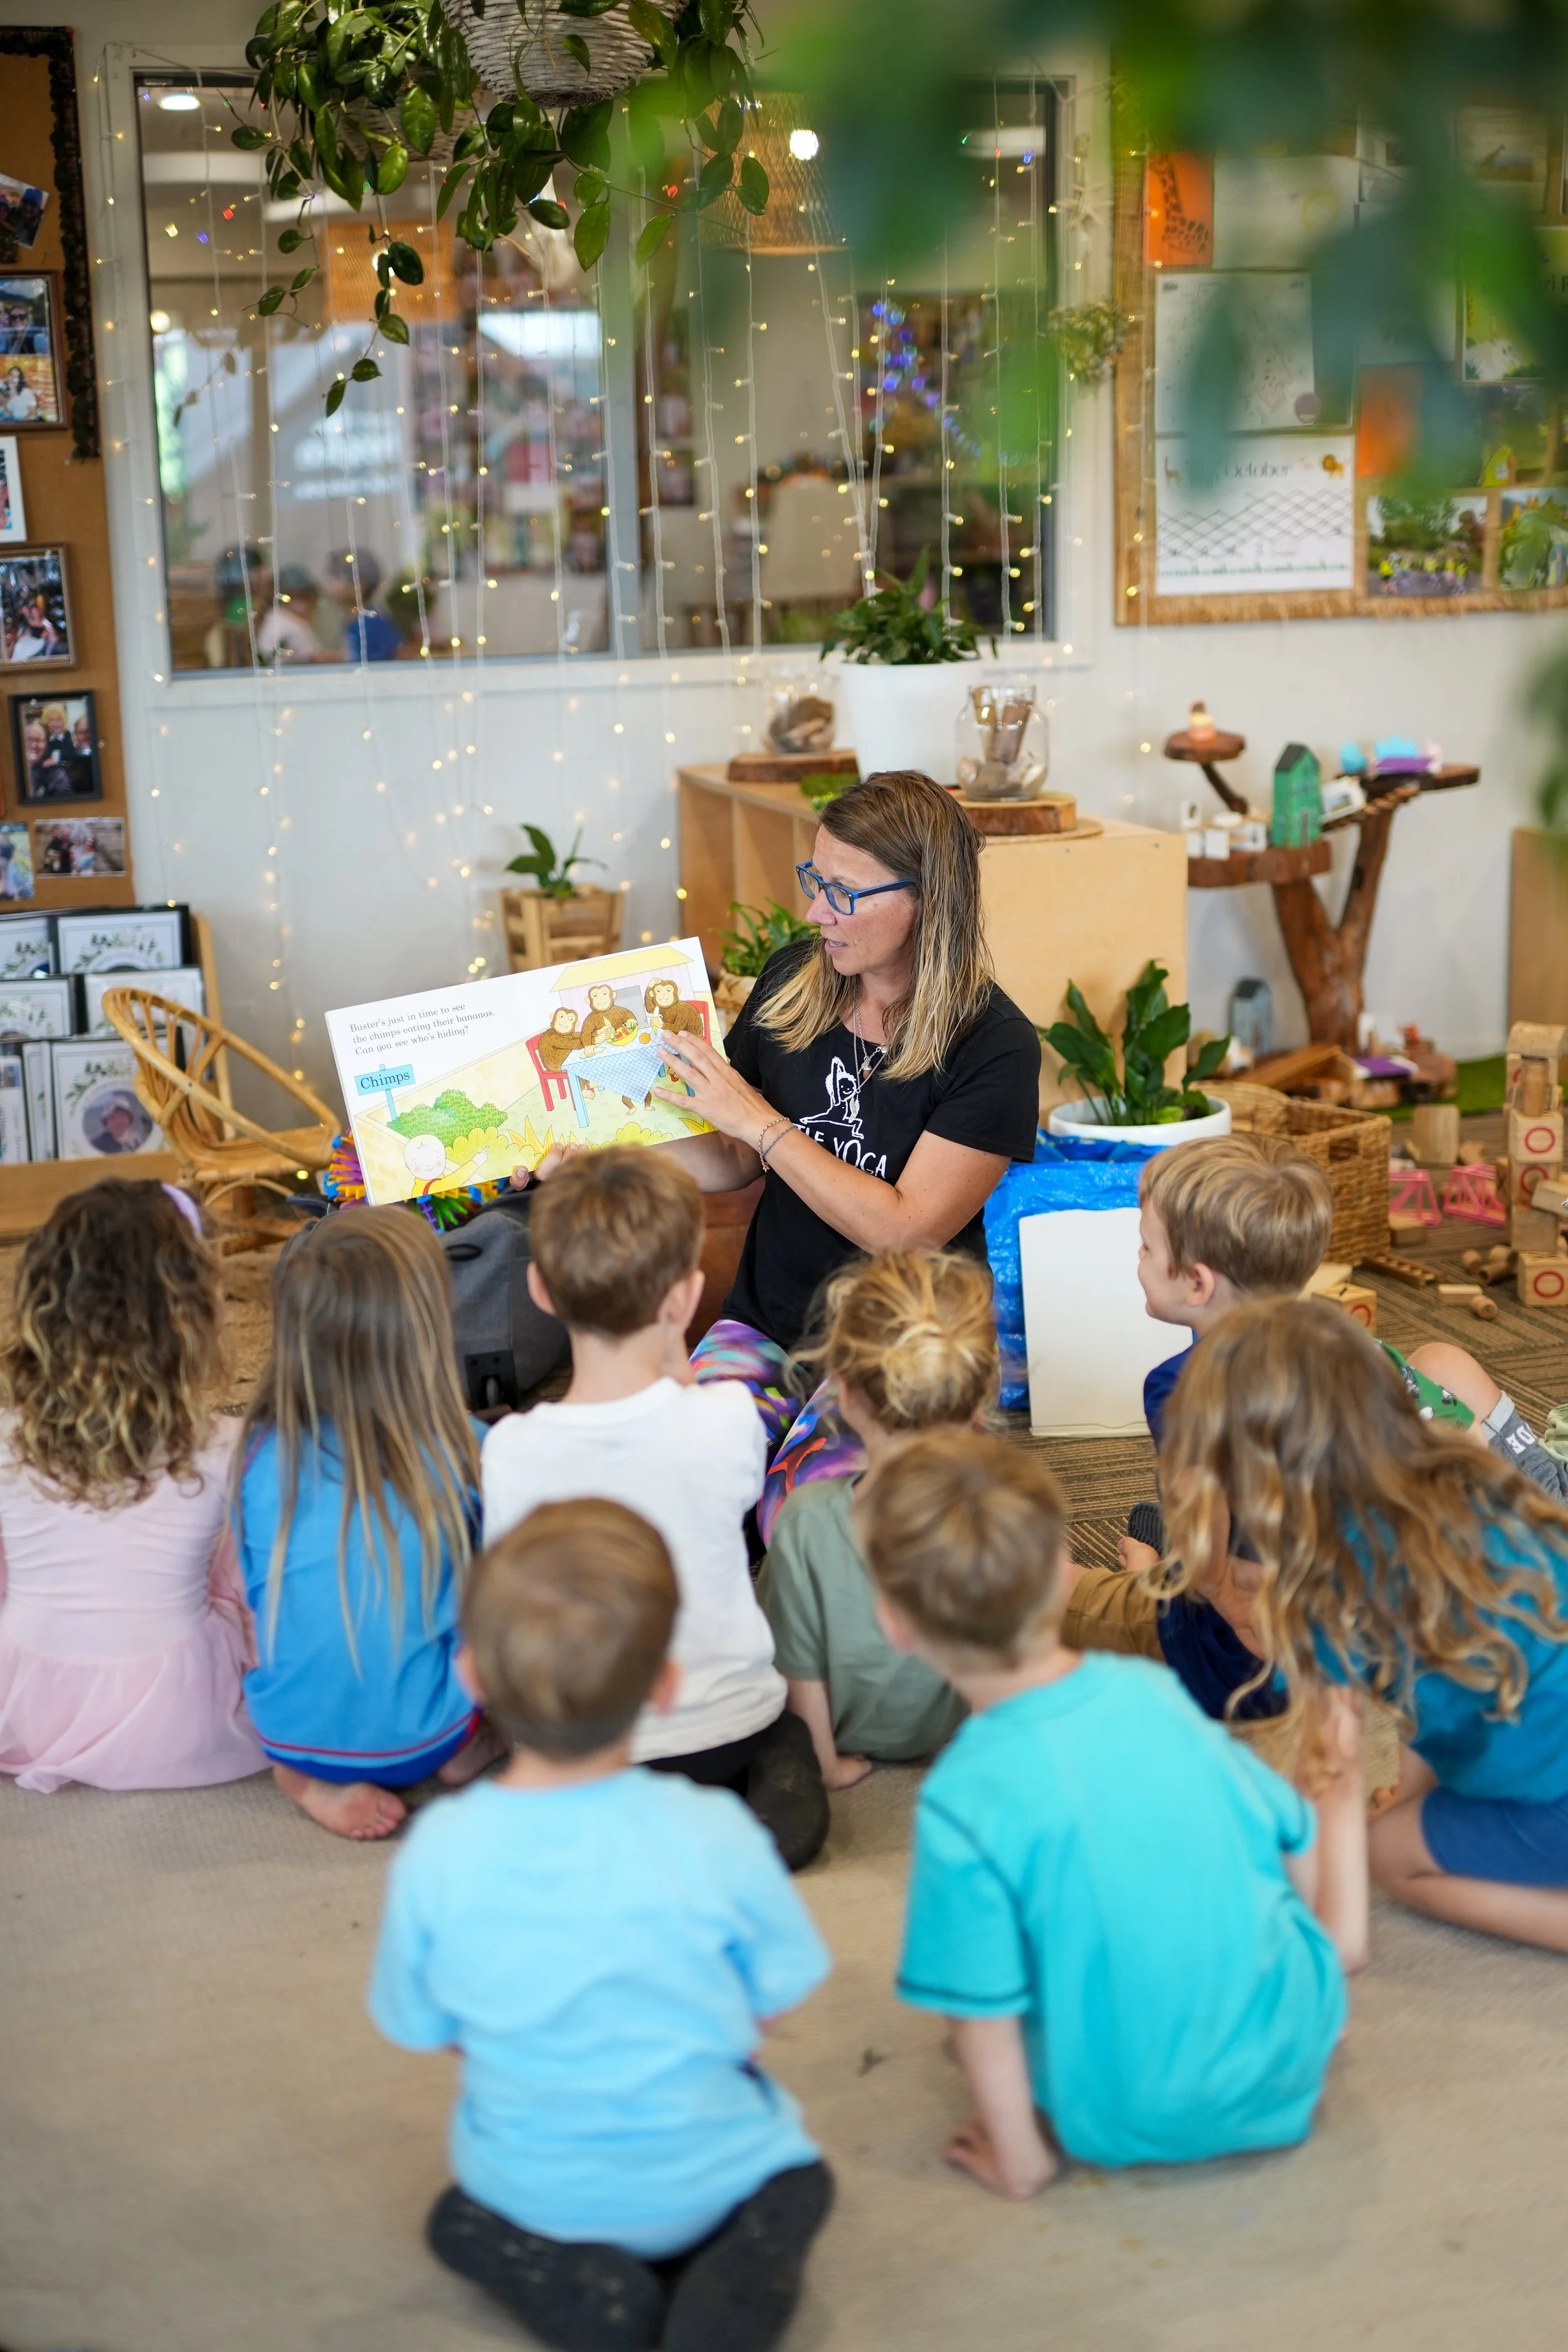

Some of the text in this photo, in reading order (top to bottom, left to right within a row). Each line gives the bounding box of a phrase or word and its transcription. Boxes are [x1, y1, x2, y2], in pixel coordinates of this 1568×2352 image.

[350, 1019, 386, 1032] Buster's
[388, 1015, 404, 1027] just
[418, 1009, 438, 1019] time
[441, 1006, 450, 1014] to
[352, 1010, 495, 1044] the chimps eating their bananas.
[355, 1046, 374, 1056] Can
[376, 1043, 392, 1053] you
[411, 1033, 435, 1044] who's
[438, 1025, 469, 1040] hiding?
[360, 1071, 410, 1089] Chimps
[834, 1137, 887, 1179] YOGA
[1506, 1422, 1537, 1454] DE
